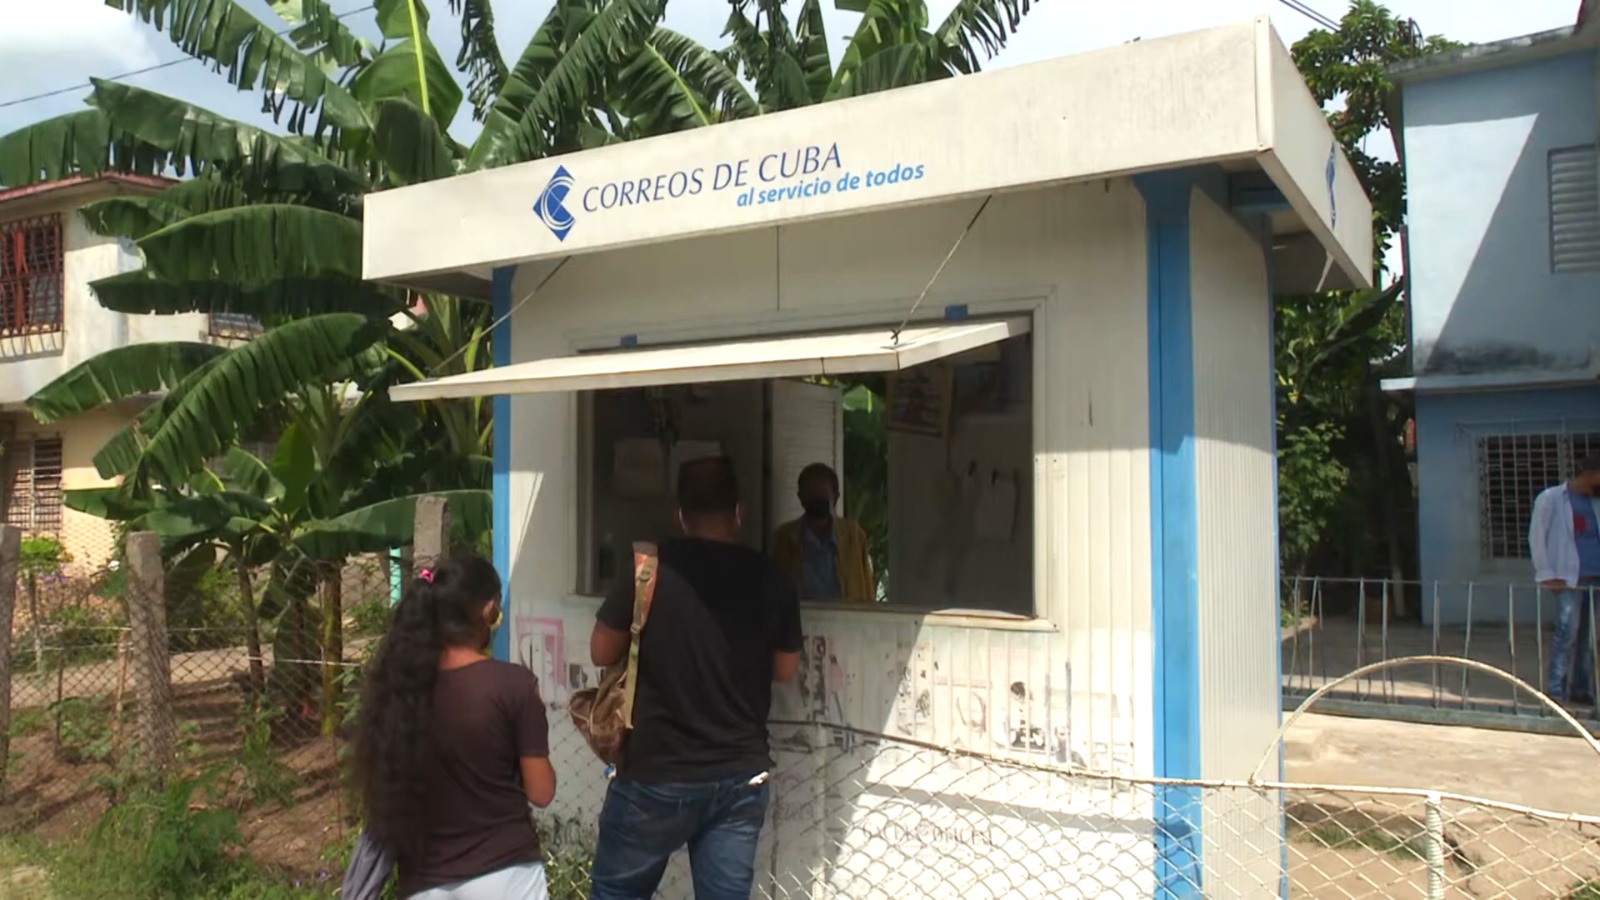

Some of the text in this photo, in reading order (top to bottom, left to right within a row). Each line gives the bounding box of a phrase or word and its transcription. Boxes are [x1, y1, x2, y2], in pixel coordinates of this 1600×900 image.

[582, 141, 842, 213] CORREOS DE CUBA
[736, 162, 925, 208] al servicio de todos
